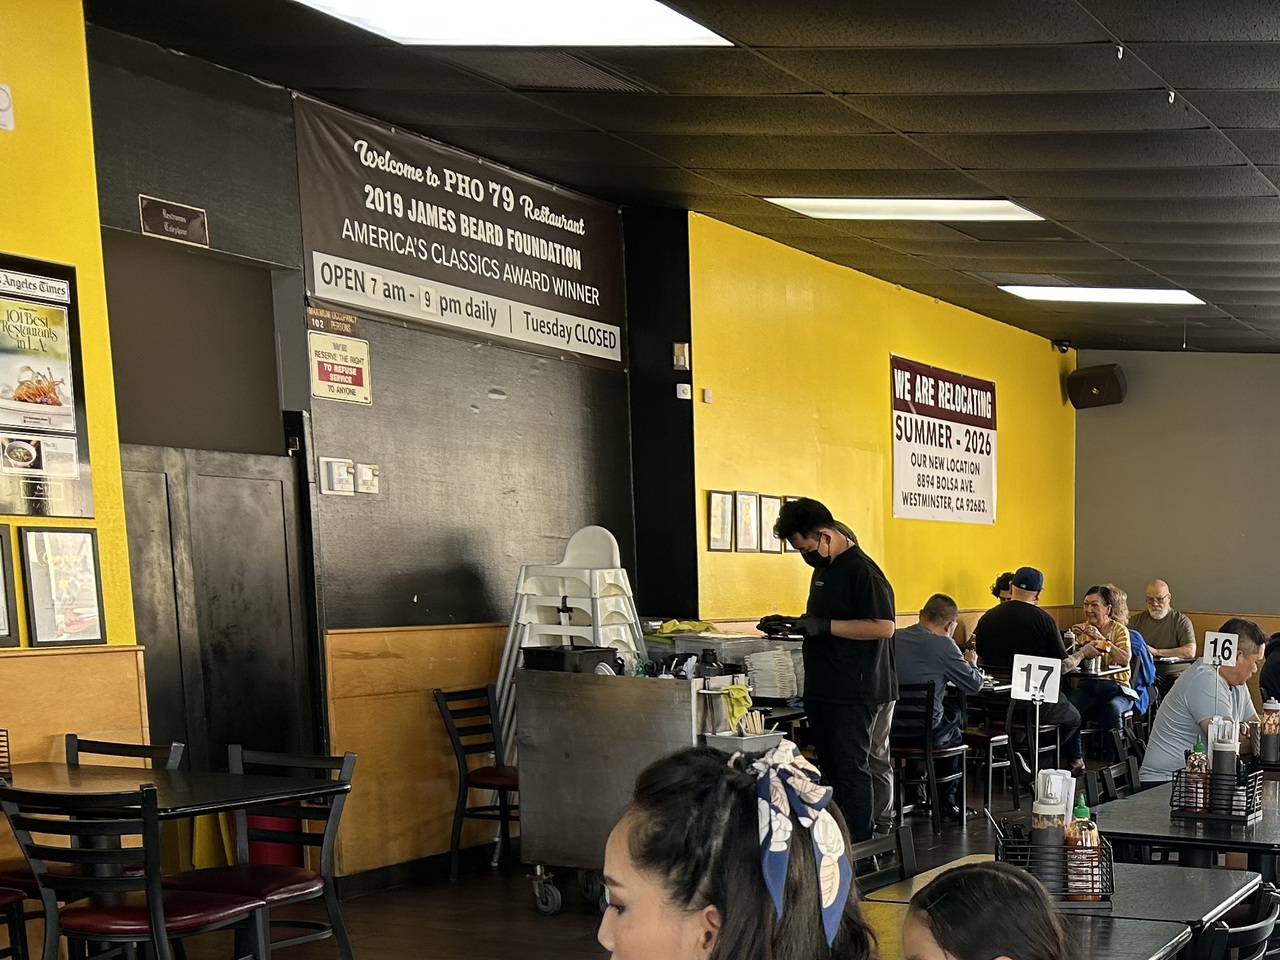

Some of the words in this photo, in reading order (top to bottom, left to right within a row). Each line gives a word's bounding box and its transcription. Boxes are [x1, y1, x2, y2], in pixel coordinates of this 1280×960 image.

[353, 139, 424, 183] Welcome
[426, 164, 441, 188] to
[444, 168, 484, 202] PHO
[519, 194, 586, 236] Restaurant
[364, 184, 404, 218] 2019
[407, 198, 457, 233] JAMES
[460, 213, 504, 248] BEARD
[506, 229, 582, 271] FOUNDATION
[342, 218, 428, 261] AMERICA'S
[431, 242, 500, 280] CLASSICS
[503, 264, 550, 293] AWARD
[552, 276, 601, 307] WINNER
[3, 273, 38, 291] Angeles
[39, 280, 66, 296] Times
[320, 261, 366, 294] OPEN
[370, 277, 378, 296] 7
[383, 281, 406, 302] am
[424, 290, 432, 309] 9
[439, 294, 462, 317] pm
[465, 296, 497, 328] daily
[523, 310, 573, 345] Tuesday
[574, 323, 617, 350] CLOSED
[1, 320, 58, 343] Restaurants
[24, 312, 49, 328] Best
[312, 318, 325, 329] 102
[314, 350, 338, 361] RESERVE
[339, 354, 349, 363] THE
[350, 356, 365, 366] RIGHT
[333, 342, 347, 352] WE
[323, 362, 333, 372] TO
[333, 364, 357, 376] REFUSE
[329, 372, 353, 384] SERVICE
[327, 384, 335, 393] TO
[336, 386, 357, 397] ANYONE
[894, 368, 912, 401] WE
[915, 374, 935, 407] ARE
[938, 379, 992, 419] RELOCATING
[895, 414, 952, 450] SUMMER
[964, 428, 992, 457] 2026
[910, 452, 928, 469] OUR
[929, 455, 945, 471] NEW
[946, 458, 981, 476] LOCATION
[916, 473, 935, 489] 8894
[936, 476, 959, 492] BOLSA
[960, 480, 976, 494] AVE.
[902, 491, 955, 513] WESTMINSTER,
[955, 497, 965, 511] CA
[1209, 637, 1233, 661] 16
[1020, 663, 1054, 694] 17
